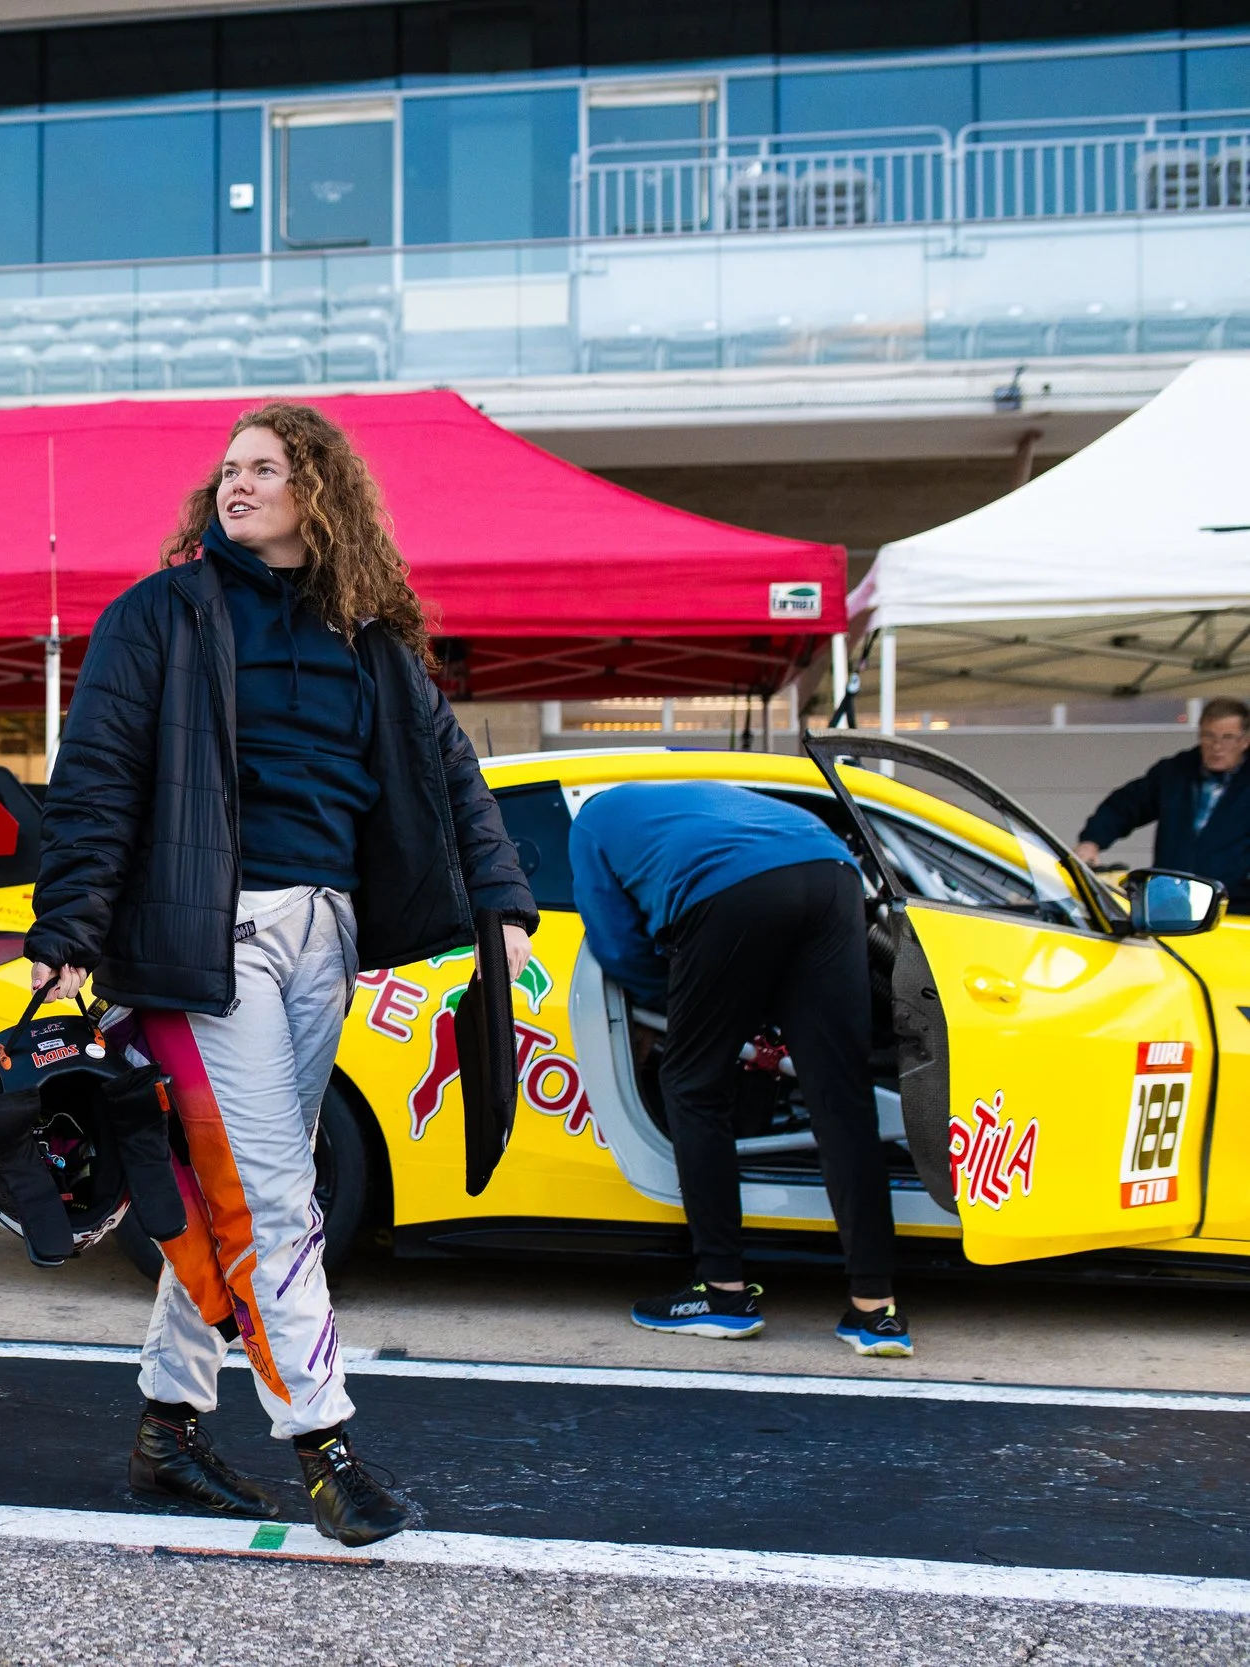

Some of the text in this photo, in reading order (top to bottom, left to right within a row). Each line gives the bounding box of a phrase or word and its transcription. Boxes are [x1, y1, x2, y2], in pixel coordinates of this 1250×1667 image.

[31, 1044, 80, 1068] hans
[1146, 1041, 1185, 1065] WRL
[1130, 1082, 1185, 1172] 188
[1130, 1178, 1170, 1207] GTO
[669, 1300, 711, 1316] HOKA
